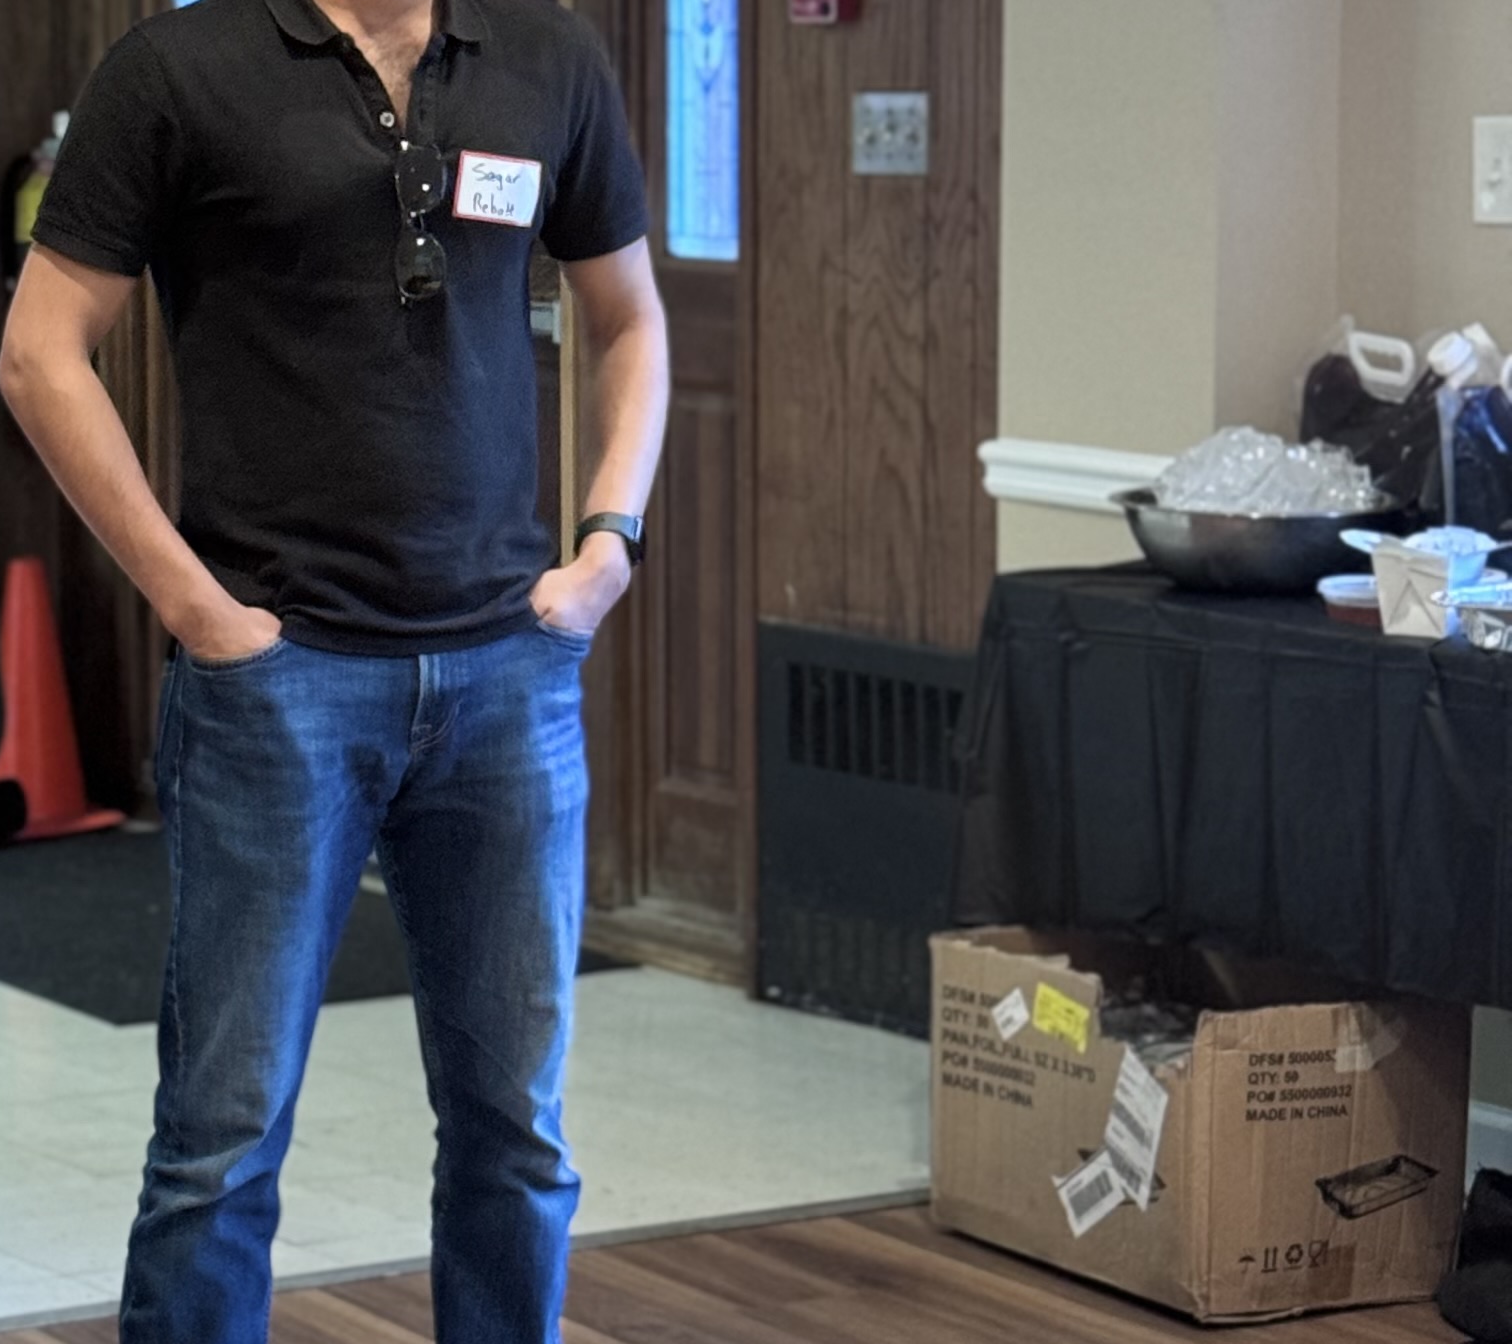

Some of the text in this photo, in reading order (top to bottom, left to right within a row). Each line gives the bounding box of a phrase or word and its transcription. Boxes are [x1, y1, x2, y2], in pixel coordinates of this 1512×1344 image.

[472, 163, 521, 191] Sagar
[1249, 1053, 1284, 1066] DFS#
[999, 1085, 1032, 1106] CHINA
[1247, 1091, 1276, 1103] PO#
[1246, 1104, 1348, 1121] MADE IN CHINA
